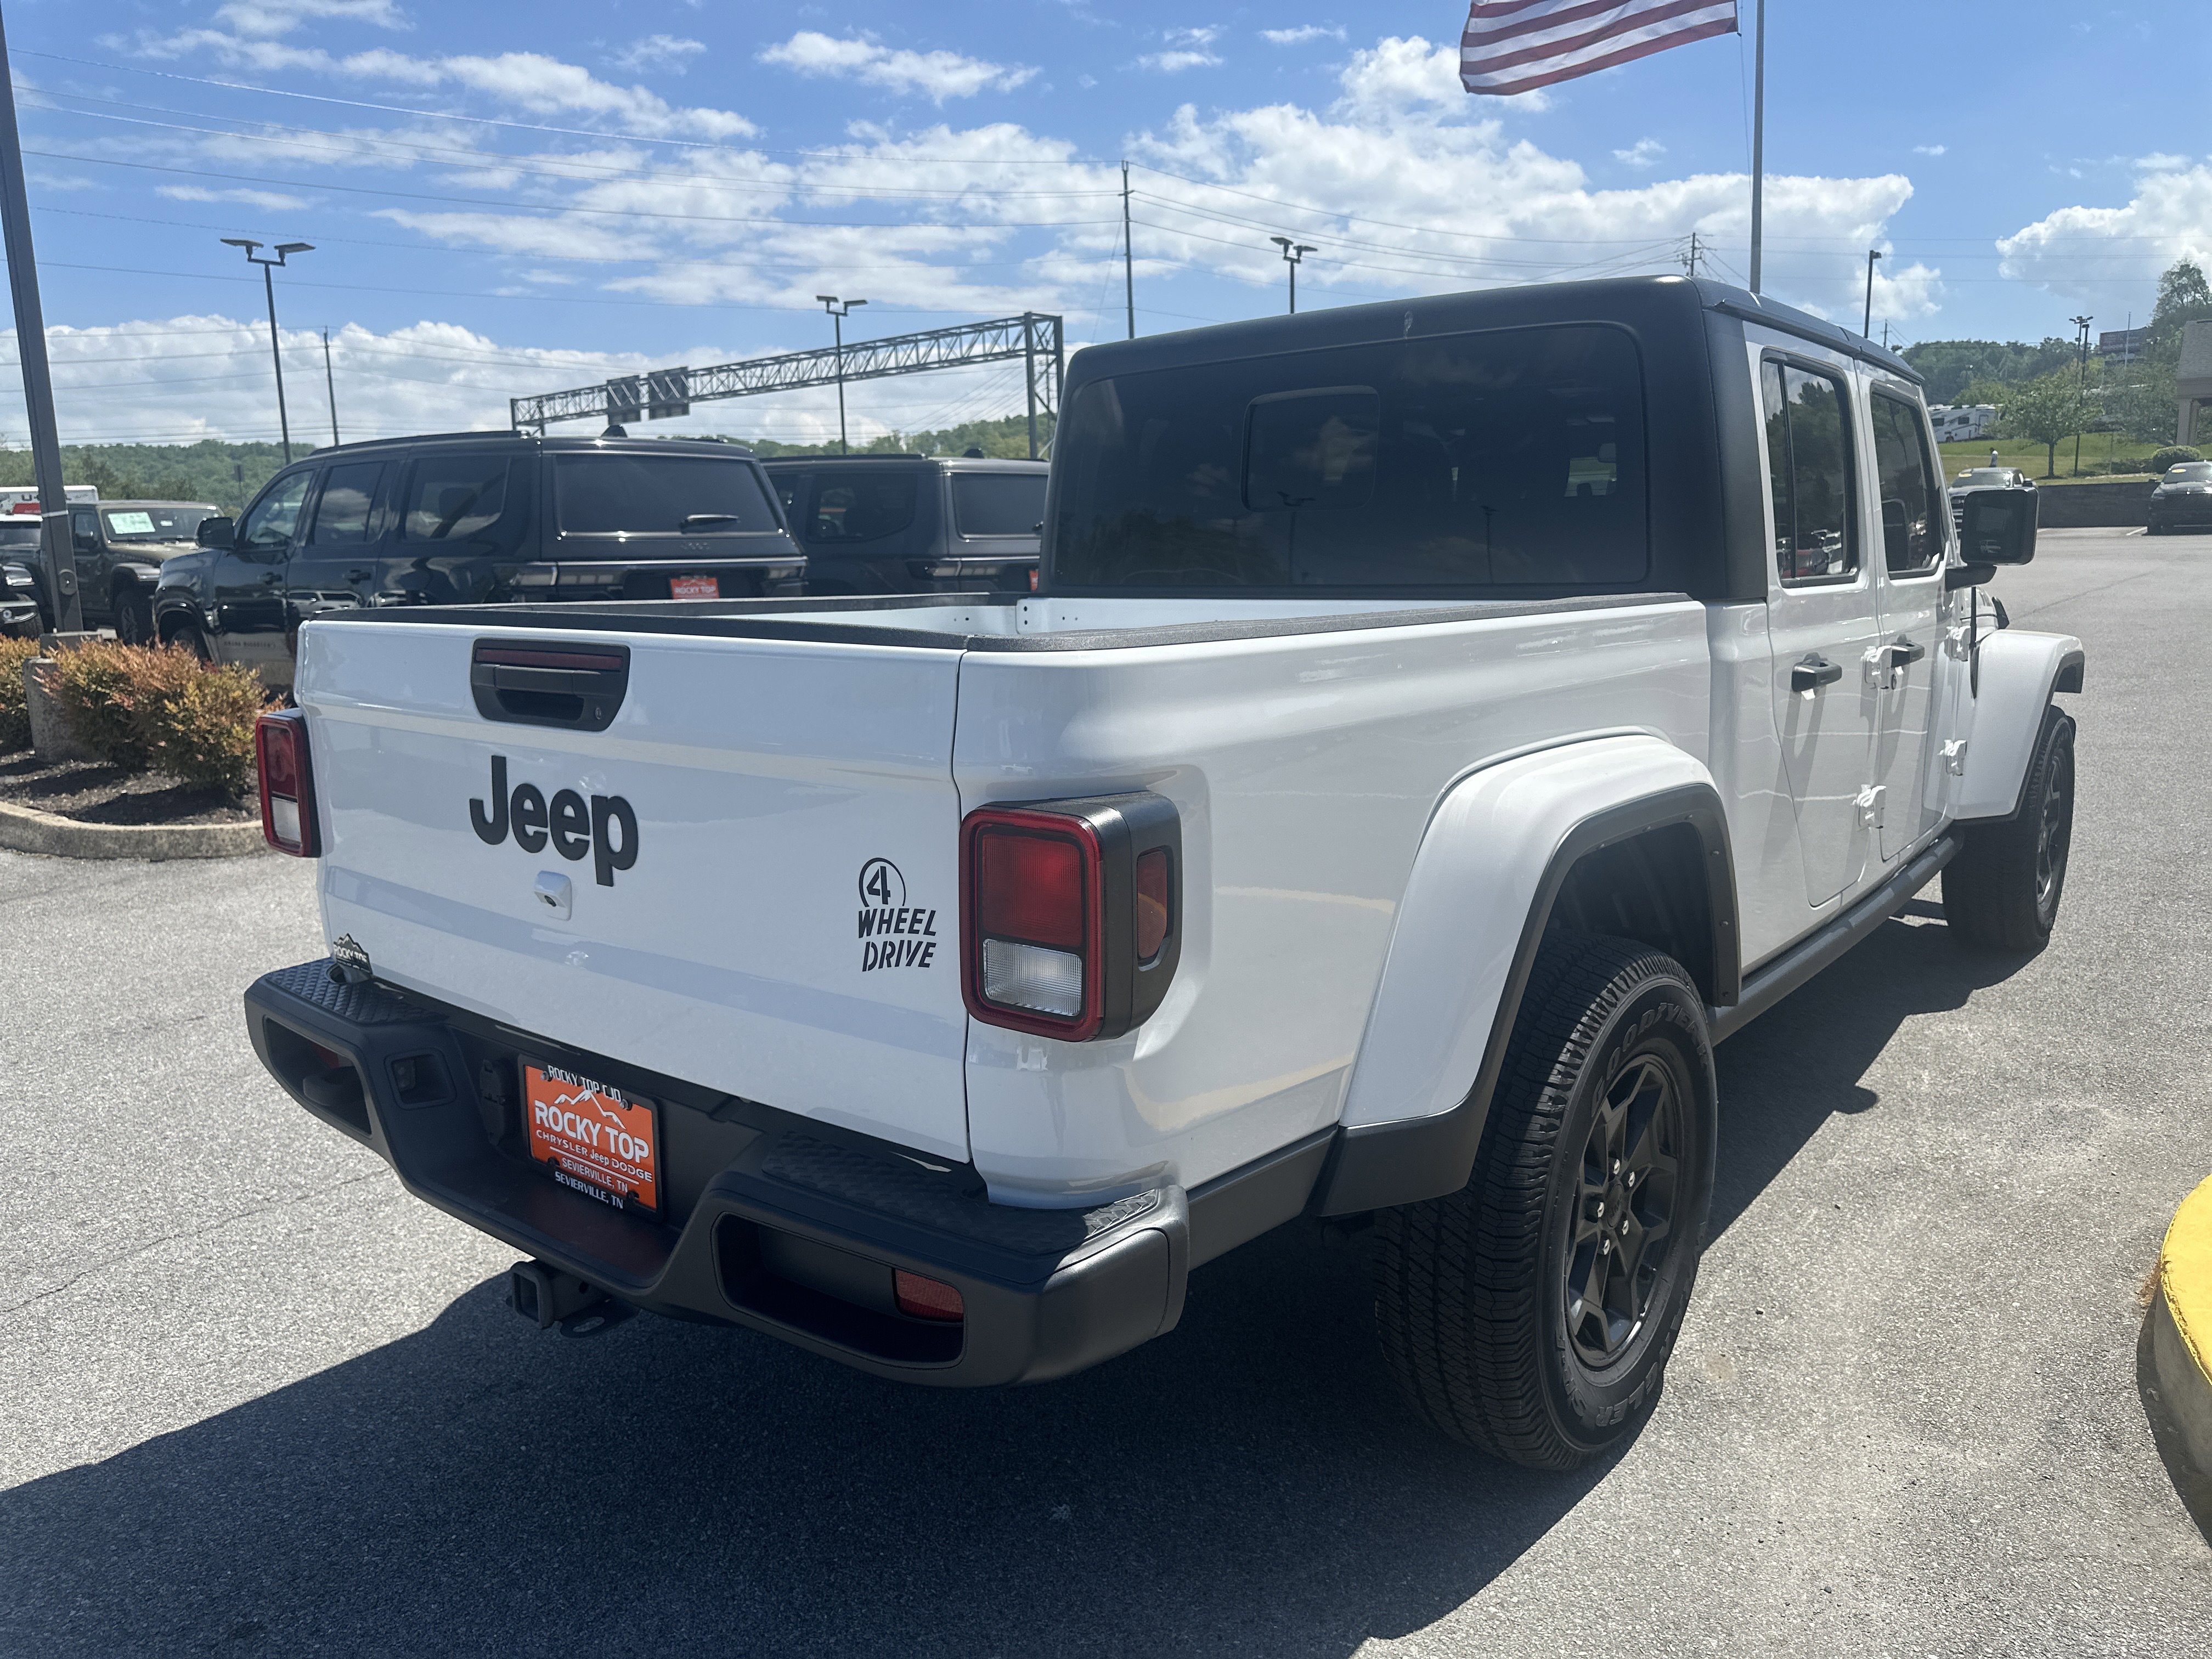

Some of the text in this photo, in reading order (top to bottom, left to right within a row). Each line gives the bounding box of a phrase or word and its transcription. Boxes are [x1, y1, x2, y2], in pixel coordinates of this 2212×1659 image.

[469, 755, 639, 887] Jeep
[866, 866, 891, 905] 4
[858, 908, 936, 939] WHEEL
[862, 940, 936, 972] DRIVE
[548, 1064, 578, 1087] ROCKY
[580, 1076, 600, 1093] TOP
[1591, 1002, 1707, 1118] GOODYEAR
[534, 1099, 650, 1164] ROCKY TOP
[536, 1129, 653, 1183] CHRYSLER Jeep DODGE
[562, 1156, 629, 1193] SEVIERVILLE, TN
[555, 1171, 624, 1209] SEVIERVILLE, TN
